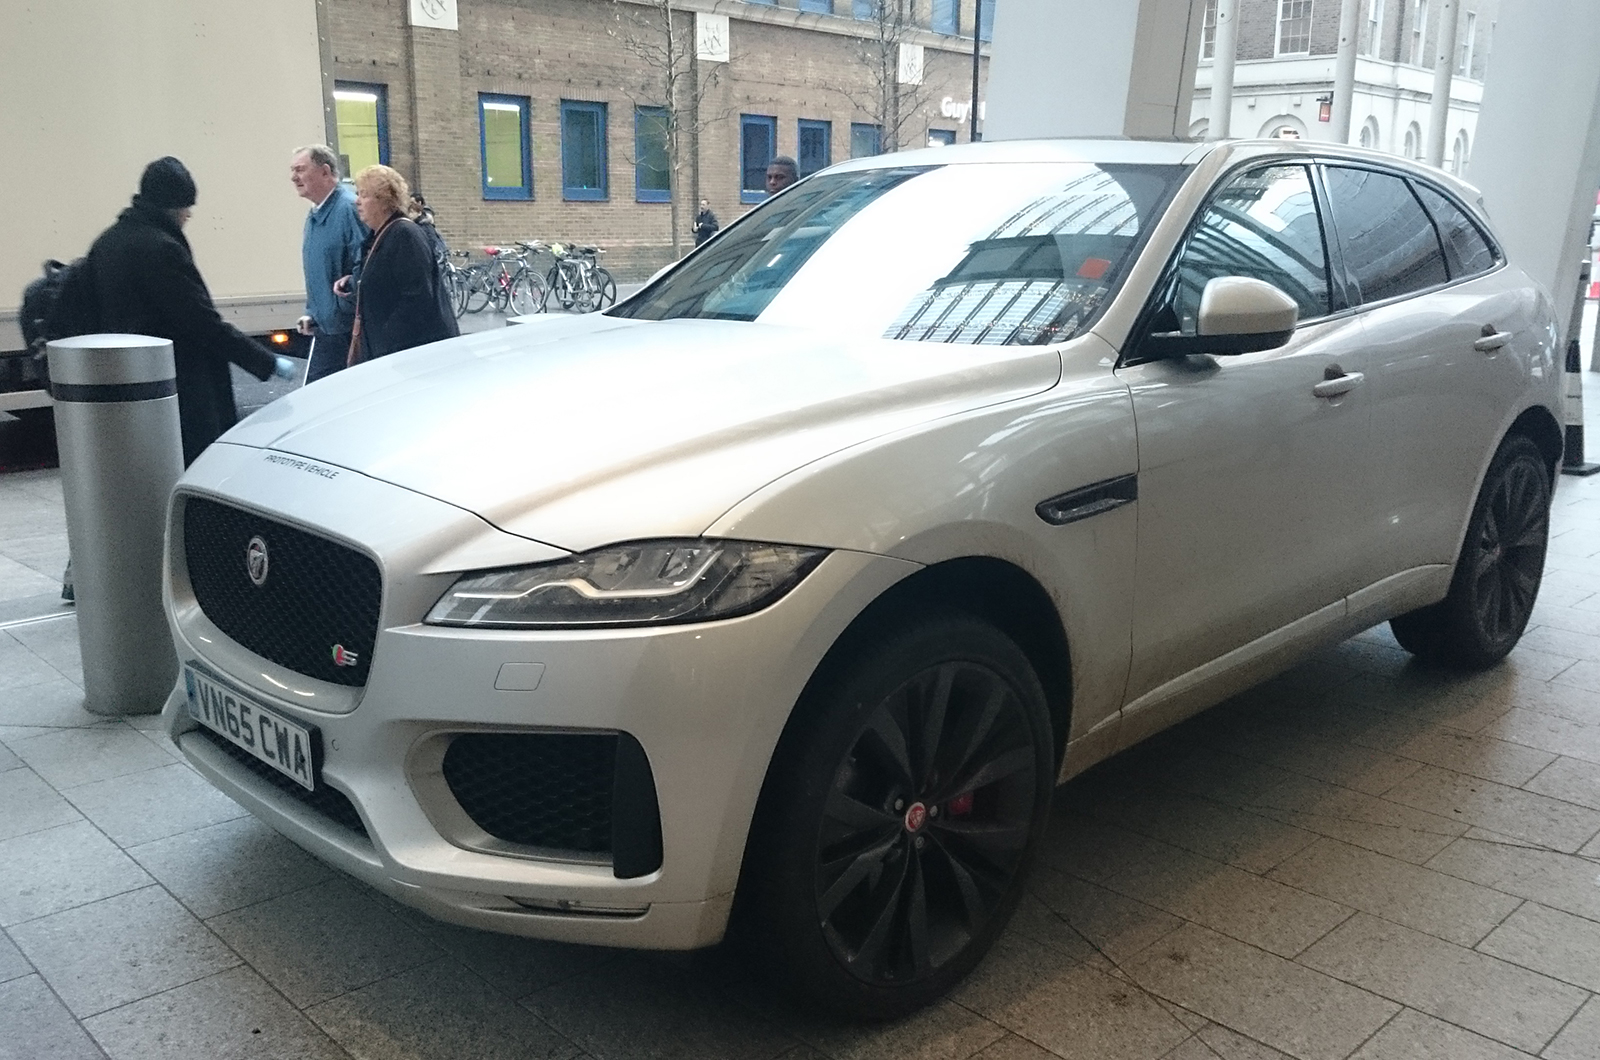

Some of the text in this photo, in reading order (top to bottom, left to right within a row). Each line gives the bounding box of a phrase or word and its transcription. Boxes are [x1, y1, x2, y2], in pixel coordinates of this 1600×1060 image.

[264, 454, 340, 480] PROTOTYPE VEHICLE
[196, 679, 308, 781] VN65 CWA
